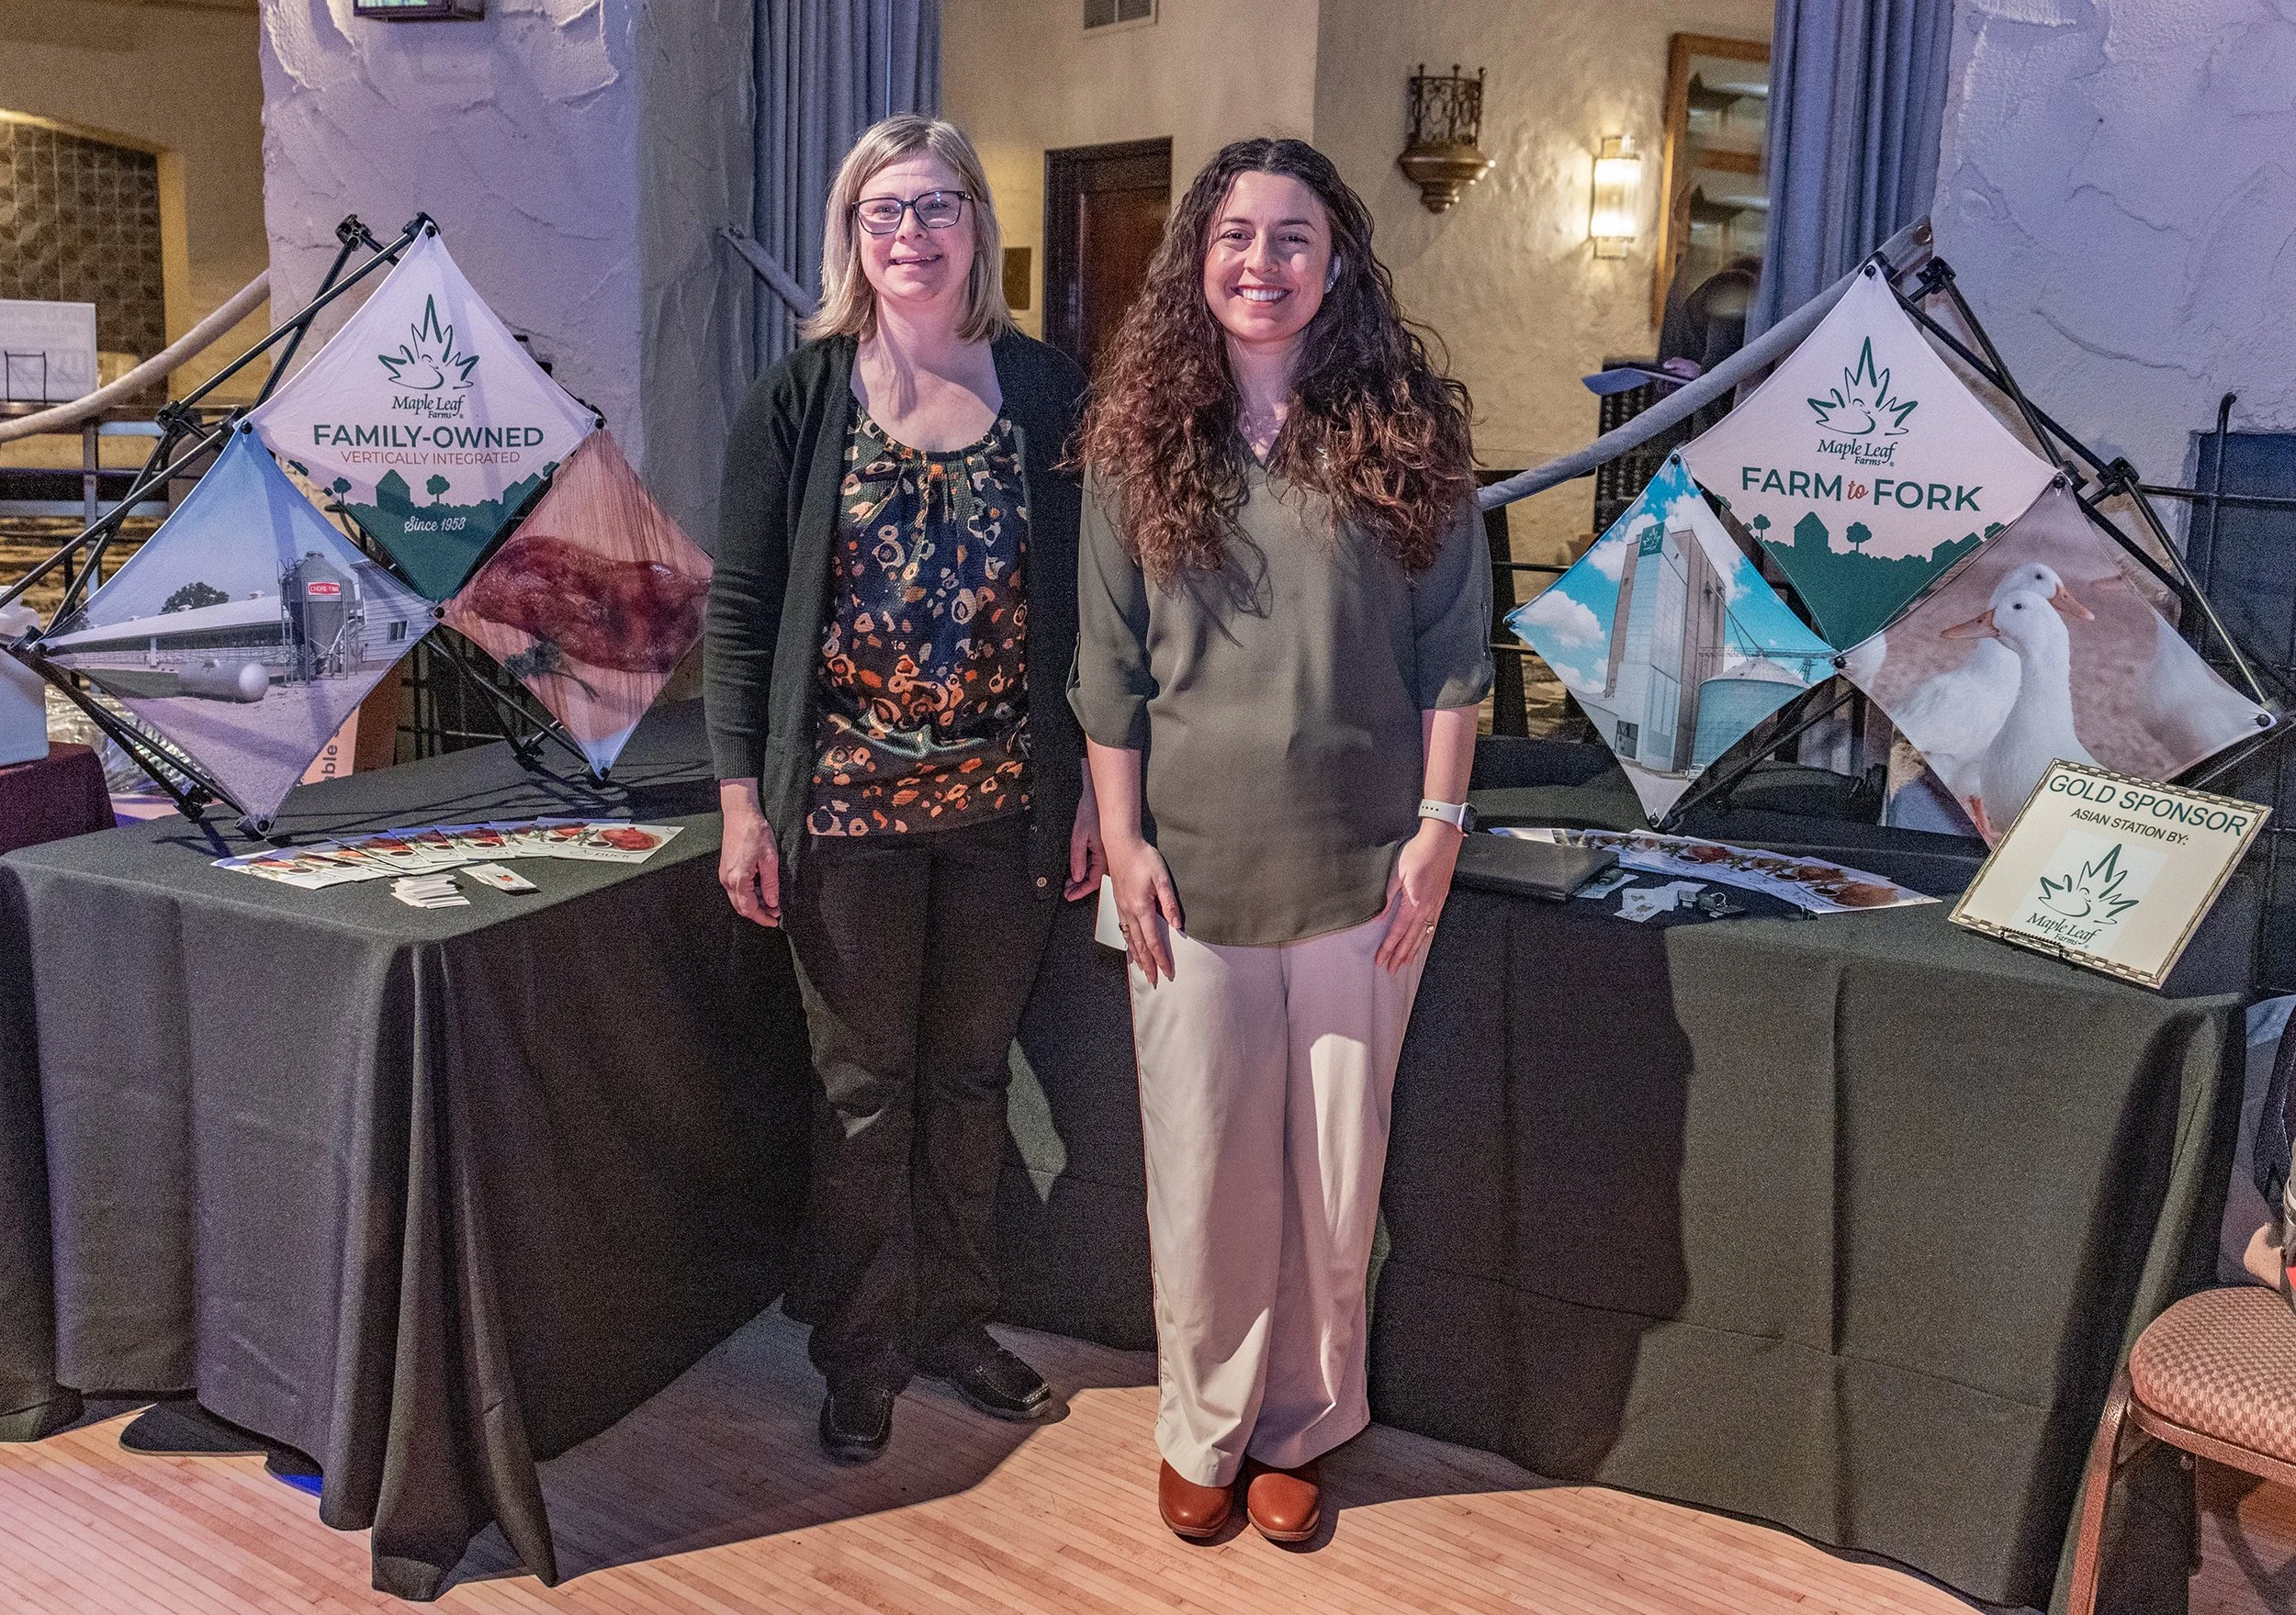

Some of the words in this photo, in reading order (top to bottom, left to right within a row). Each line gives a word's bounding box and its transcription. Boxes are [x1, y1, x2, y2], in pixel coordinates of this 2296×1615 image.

[391, 394, 433, 416] Maple
[436, 395, 467, 418] Leaf
[428, 410, 453, 420] Farms
[313, 424, 544, 448] FAMILY-OWNED
[341, 451, 427, 465] VERTICALLY
[433, 451, 520, 465] INTEGRATED
[1817, 438, 1862, 461] Maple
[1863, 442, 1898, 464] Leaf
[1854, 455, 1882, 466] Farms
[1742, 466, 1842, 502] FARM
[1847, 480, 1869, 500] to
[1874, 478, 1984, 511] FORK
[404, 516, 438, 533] Since
[441, 517, 467, 532] 1958
[2049, 774, 2116, 803] GOLD
[2119, 791, 2248, 836] SPONSOR
[2070, 808, 2111, 827] ASIAN
[2110, 818, 2166, 840] STATION
[2167, 832, 2189, 846] BY:
[2026, 912, 2067, 935] Maple
[2068, 925, 2102, 947] Leaf
[2054, 933, 2080, 946] Farms
